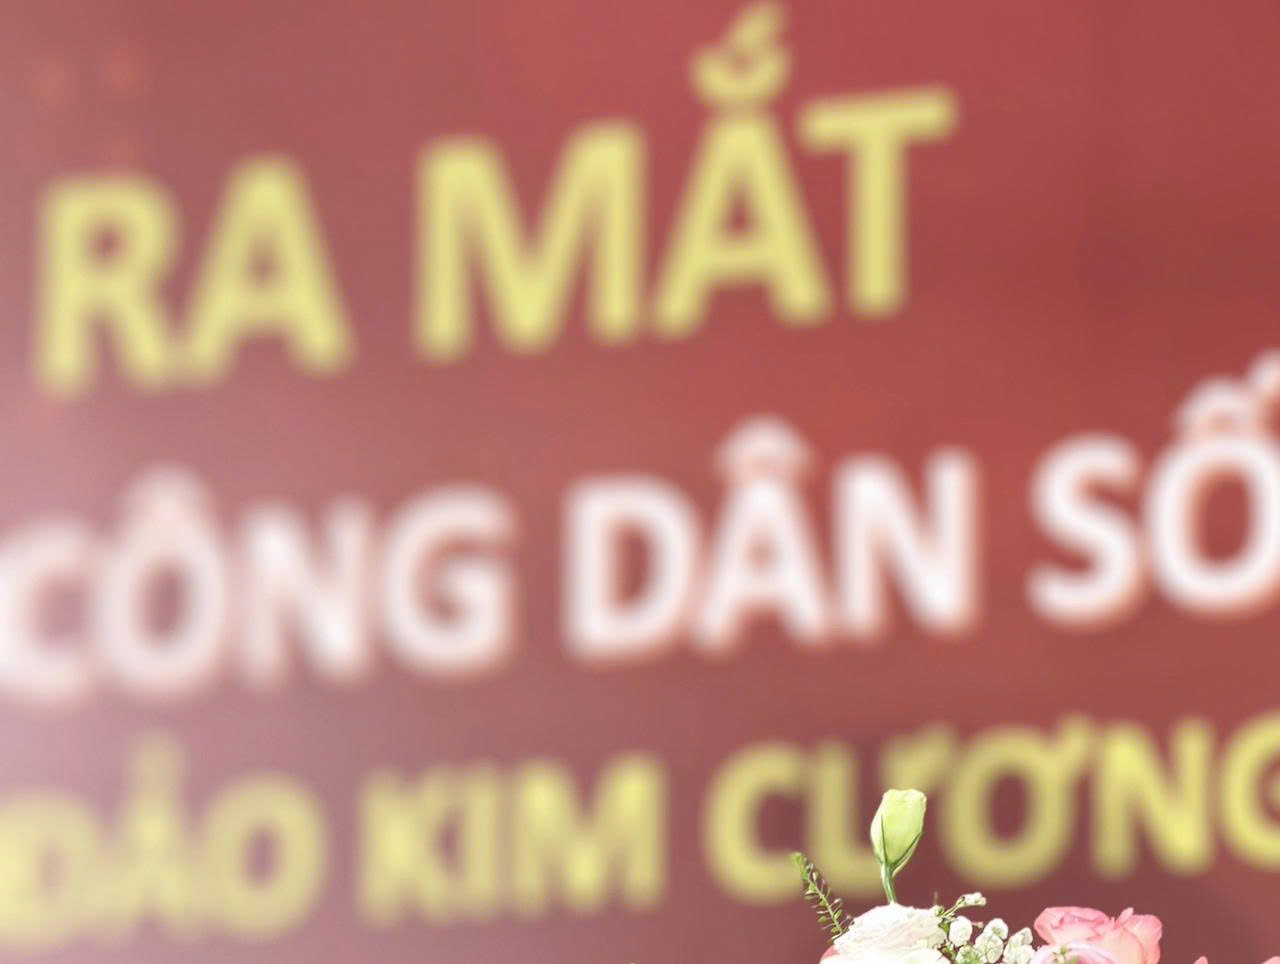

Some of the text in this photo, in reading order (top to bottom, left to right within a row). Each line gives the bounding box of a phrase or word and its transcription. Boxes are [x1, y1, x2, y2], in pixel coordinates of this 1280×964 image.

[42, 2, 955, 391] RA MẮT
[0, 467, 515, 698] CÔNG
[564, 415, 977, 660] DÂN
[358, 755, 667, 923] KIM
